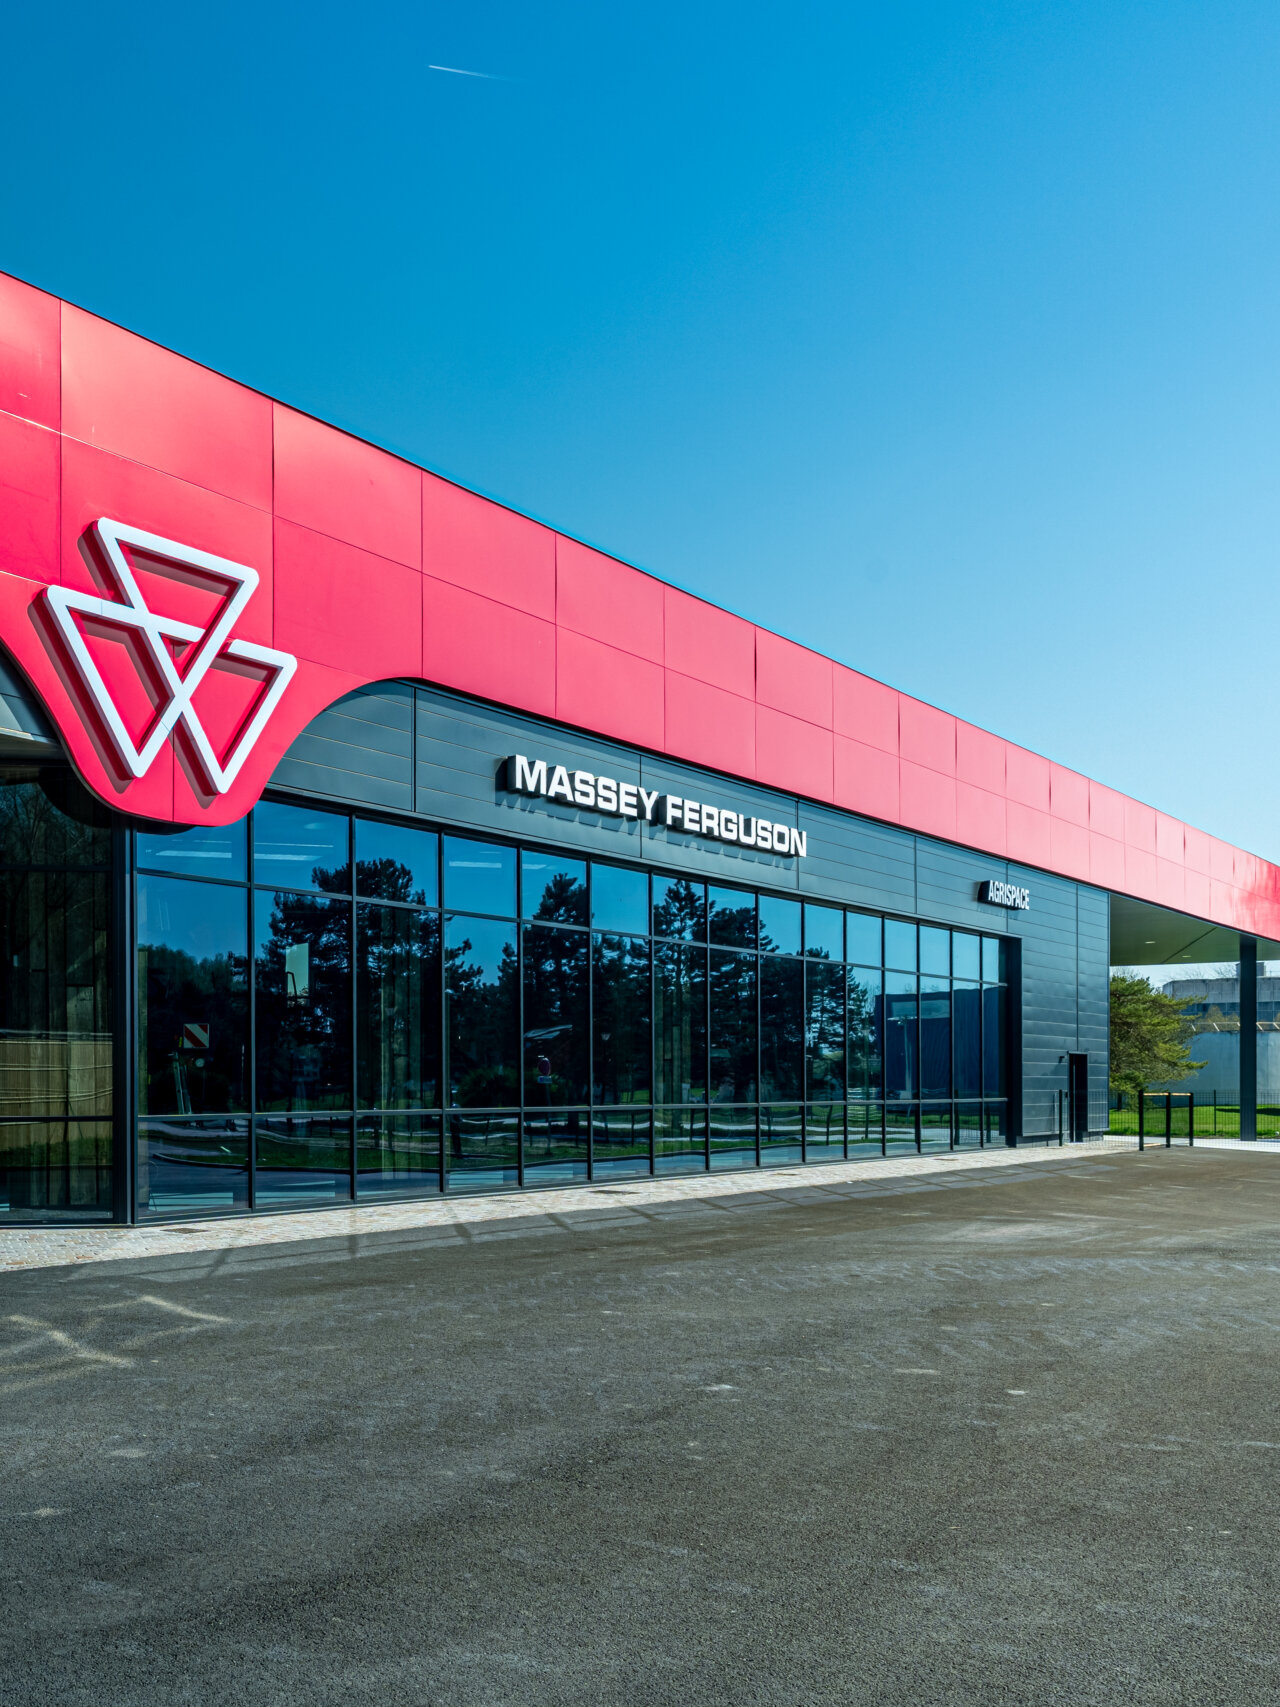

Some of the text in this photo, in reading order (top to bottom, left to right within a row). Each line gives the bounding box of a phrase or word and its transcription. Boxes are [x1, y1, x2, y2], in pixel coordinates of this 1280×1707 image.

[515, 754, 807, 858] MASSEY FERGUSON
[988, 880, 1030, 910] AGRISPACE
